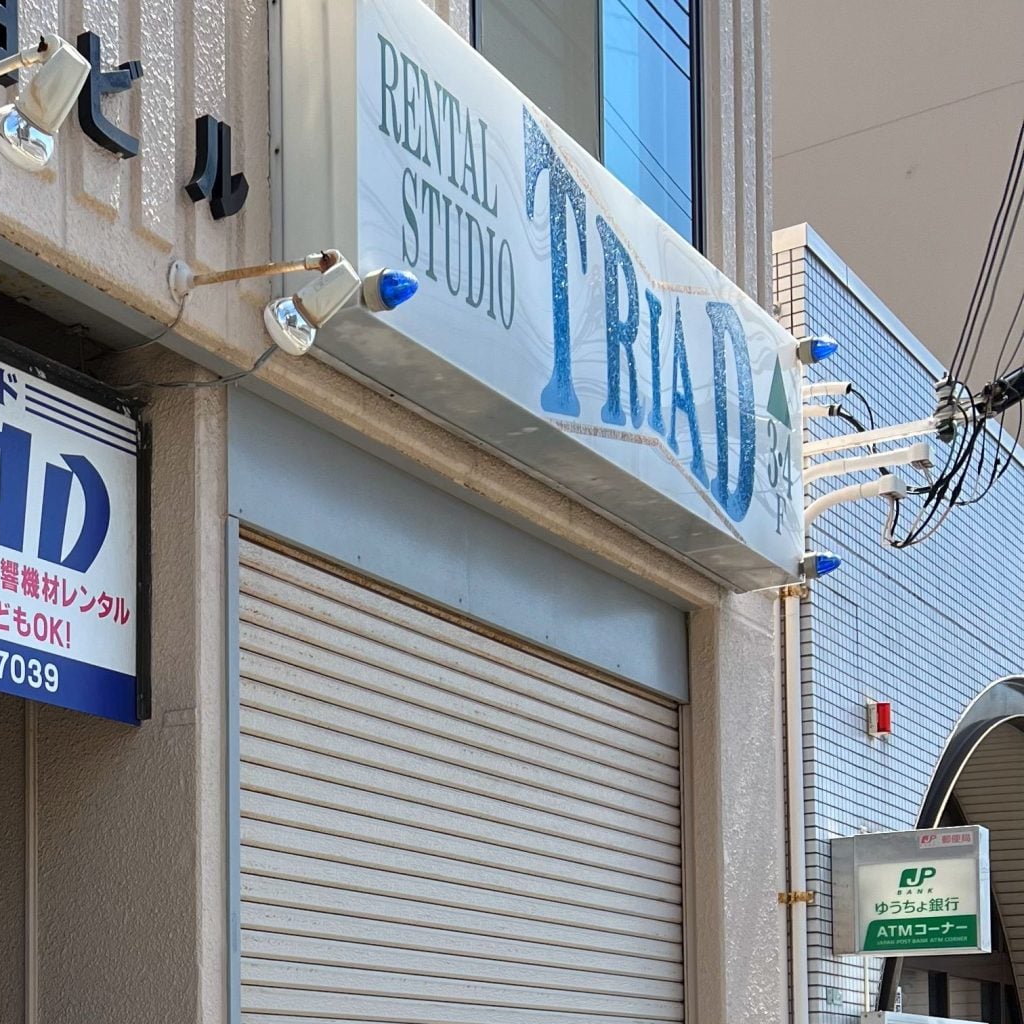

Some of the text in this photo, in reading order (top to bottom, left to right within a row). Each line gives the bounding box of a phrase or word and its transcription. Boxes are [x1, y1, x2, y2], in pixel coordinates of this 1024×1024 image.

[377, 32, 498, 218] RENTAL
[402, 167, 515, 330] STUDIO
[523, 104, 755, 522] TRIAD
[875, 897, 959, 915] ゆうちょ銀行
[899, 867, 936, 888] JP
[877, 922, 968, 938] ATMコーナー
